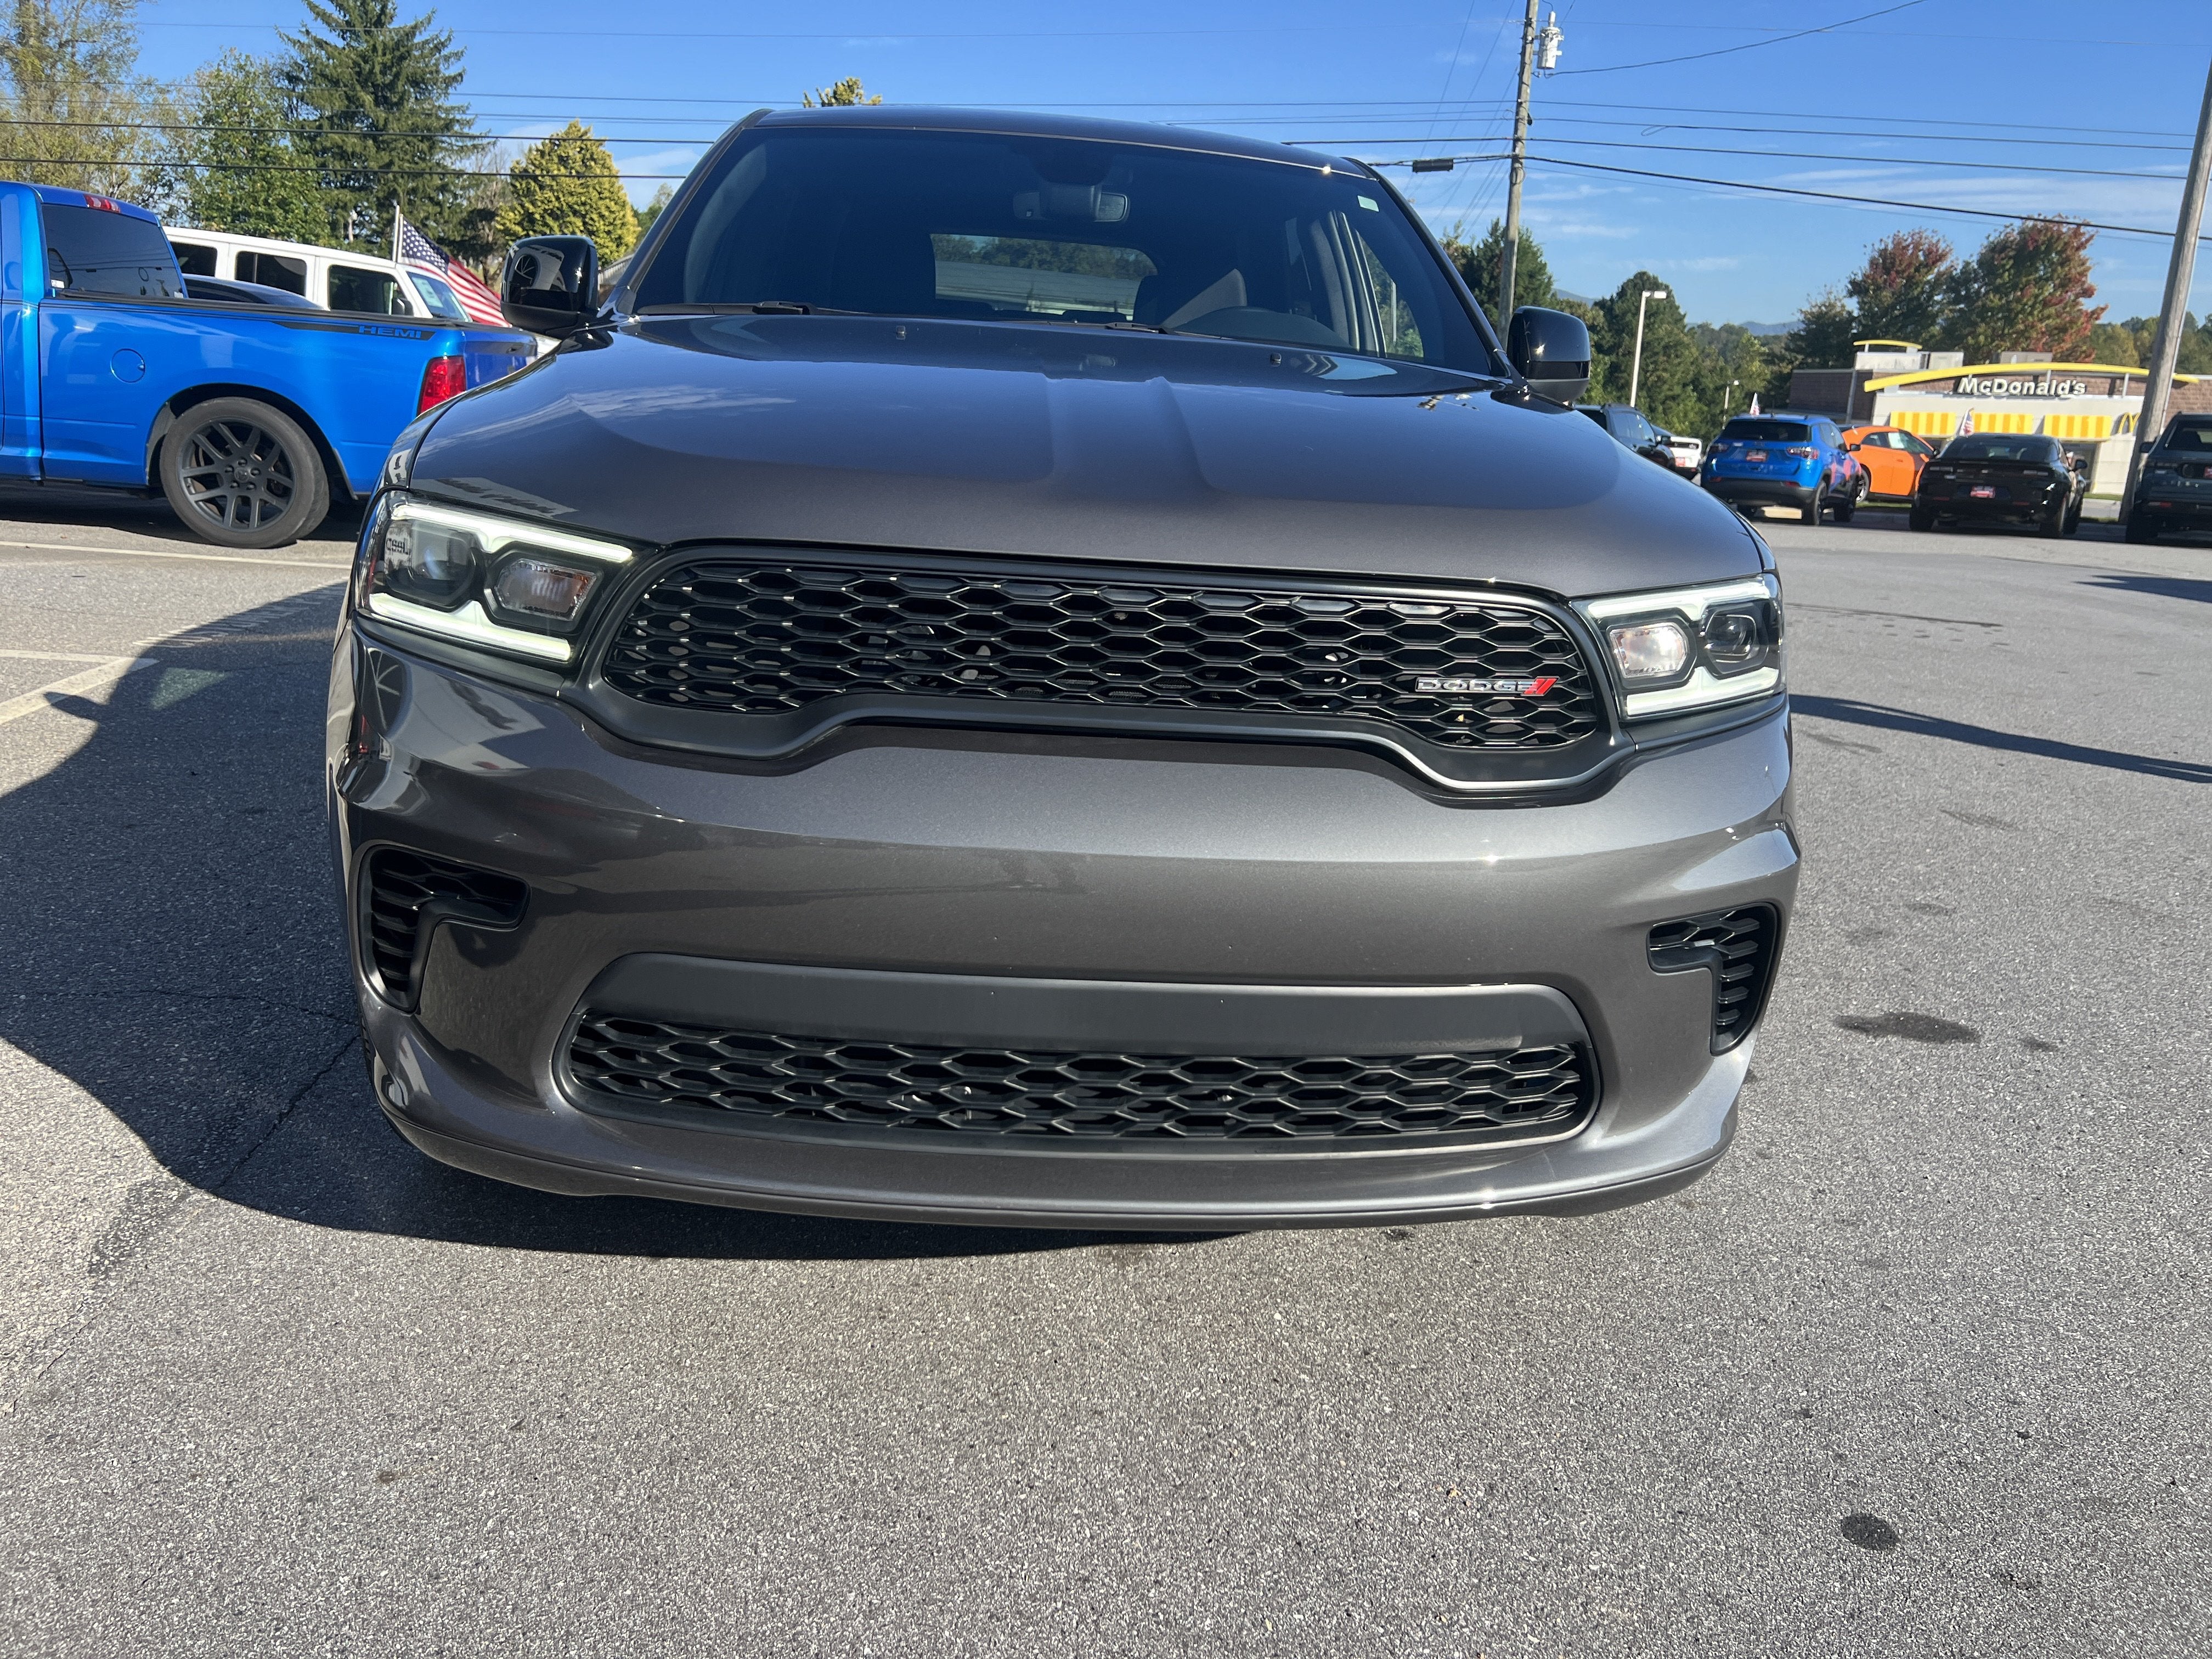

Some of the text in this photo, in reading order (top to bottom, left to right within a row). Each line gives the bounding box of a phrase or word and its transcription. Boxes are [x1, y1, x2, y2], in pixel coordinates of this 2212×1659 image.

[359, 325, 422, 338] HEMI
[1957, 377, 2085, 396] McDonald's
[1417, 679, 1538, 691] DODGE
